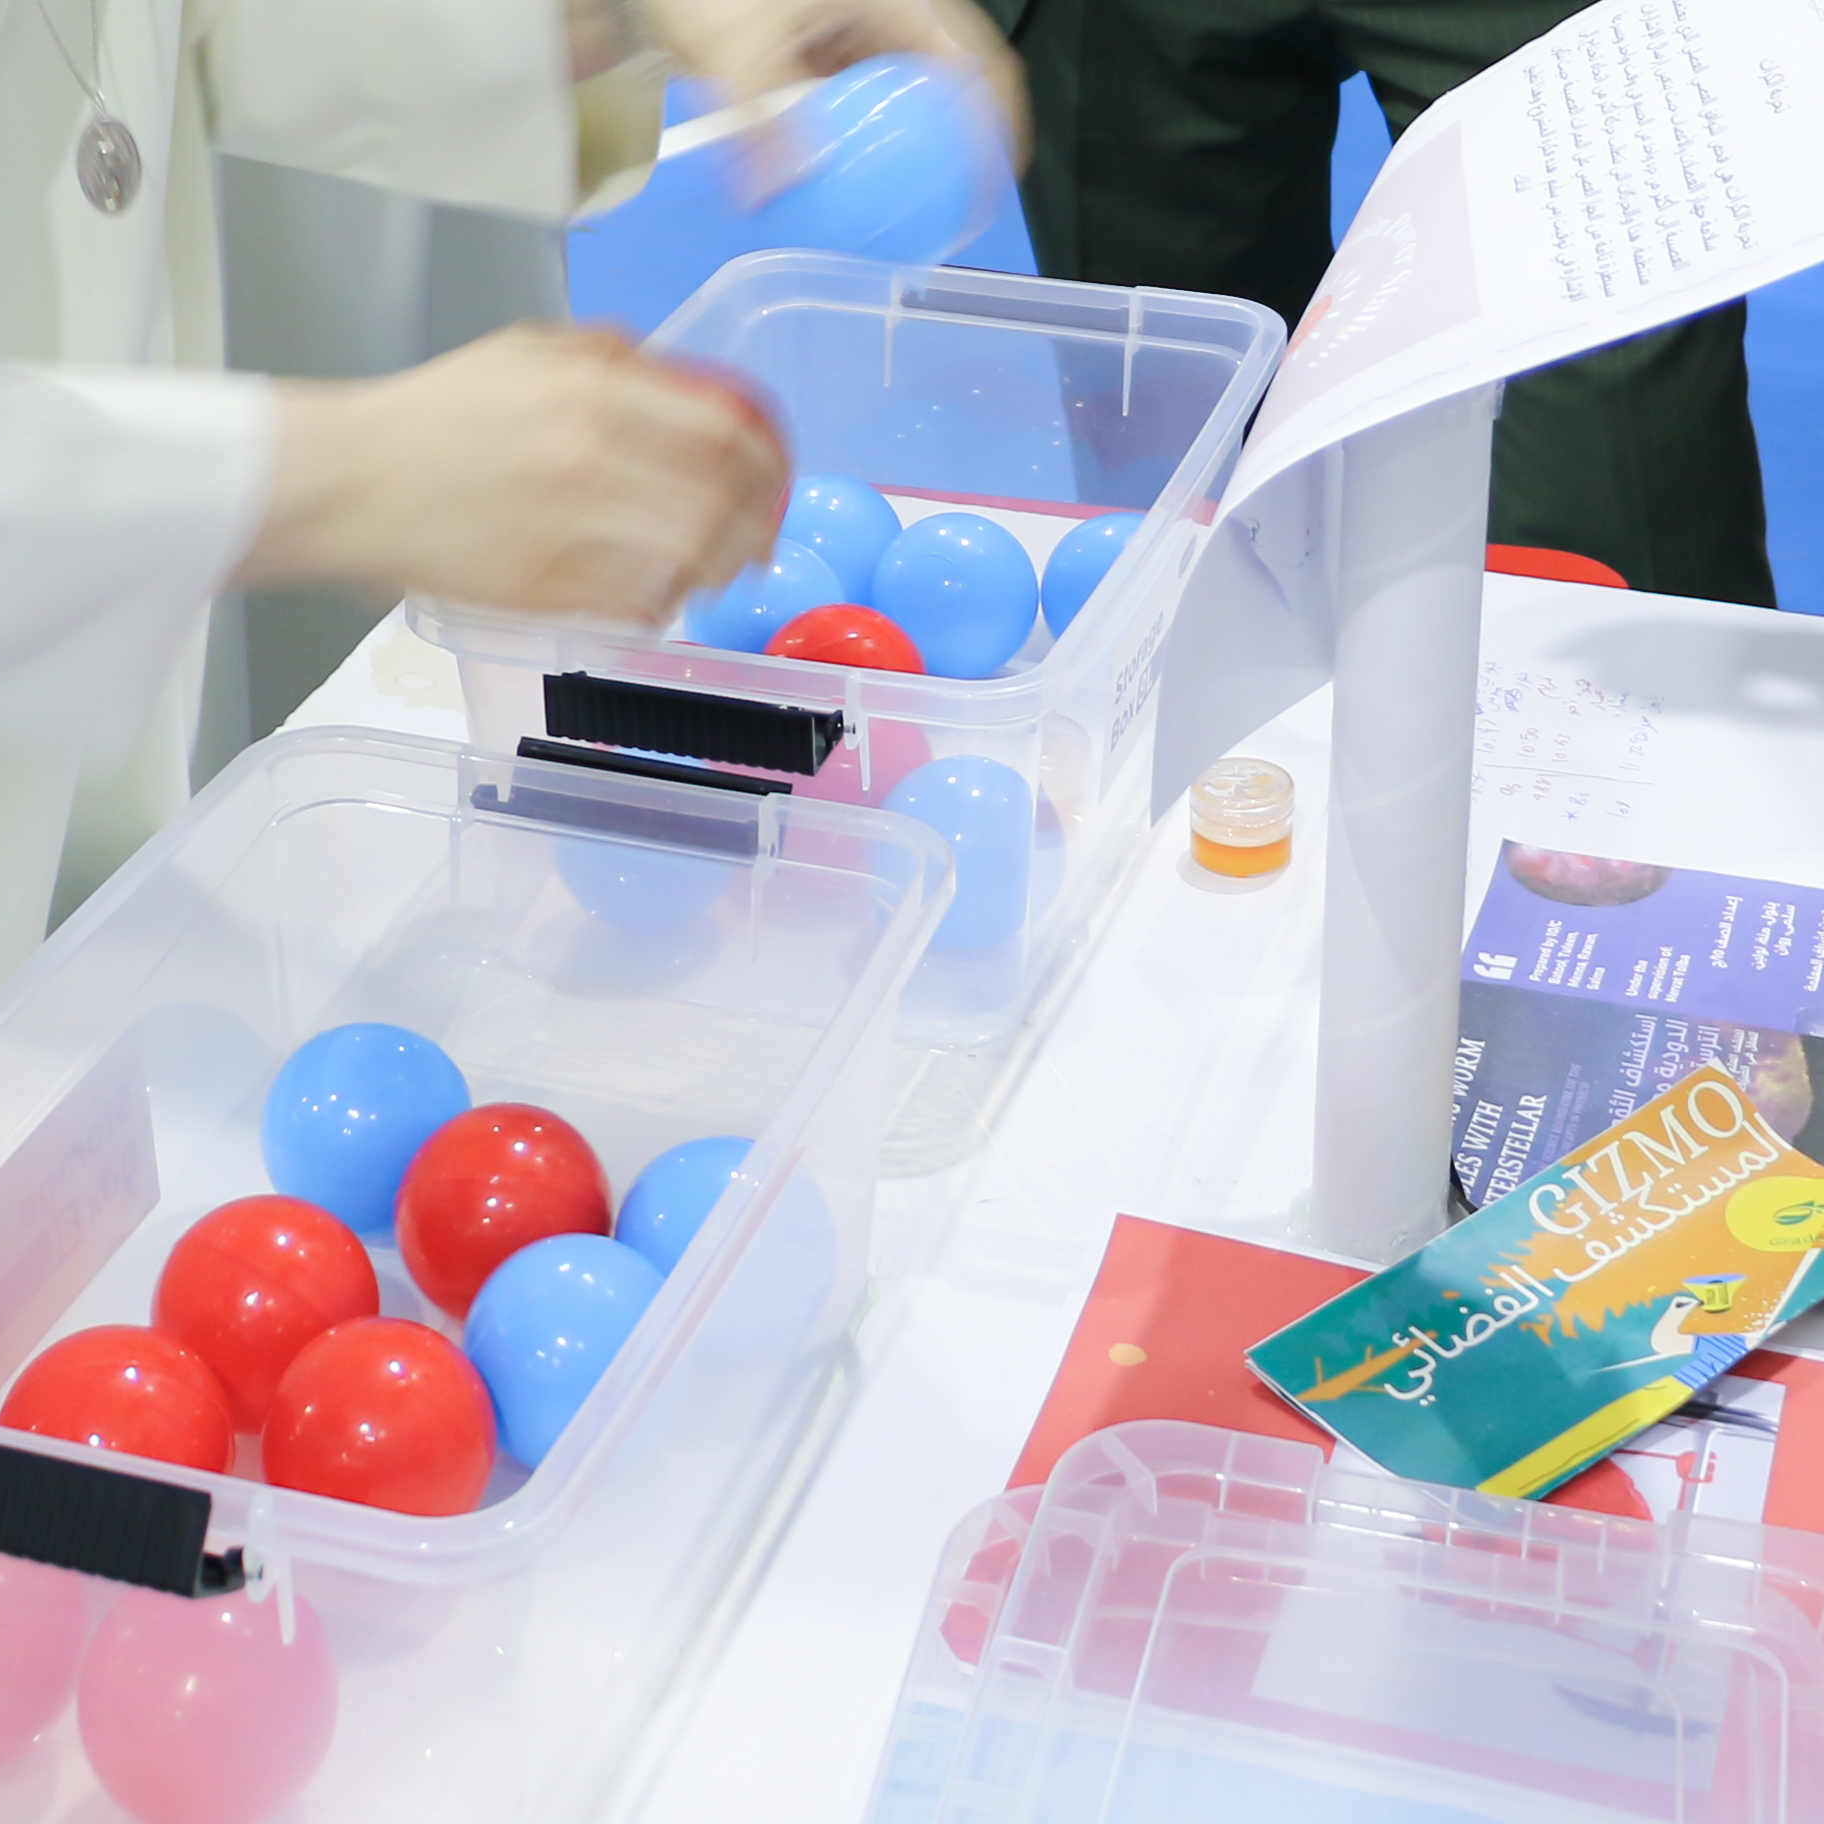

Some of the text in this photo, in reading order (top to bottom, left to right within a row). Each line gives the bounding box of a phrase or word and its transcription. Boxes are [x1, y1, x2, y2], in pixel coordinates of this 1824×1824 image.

[1114, 610, 1164, 706] Storage
[1110, 706, 1135, 753] Box
[1722, 896, 1743, 921] إعداد
[1715, 922, 1732, 948] الصف
[1529, 947, 1552, 981] Prepared
[1541, 938, 1558, 947] by
[1587, 968, 1605, 990] Salma
[1625, 960, 1648, 996] Under the
[1648, 958, 1669, 999] supervision
[1803, 959, 1823, 991] المعلمة
[1453, 1038, 1485, 1095] WORM
[1620, 1015, 1657, 1086] استكشاف
[1654, 1020, 1688, 1081] الدودية
[1462, 1101, 1503, 1149] WITH
[1483, 1096, 1547, 1203] TERSTELLAR
[1528, 1080, 1744, 1237] GIZMO
[1455, 1153, 1482, 1199] LES
[1383, 1112, 1794, 1408] المستكشف الفضائي
